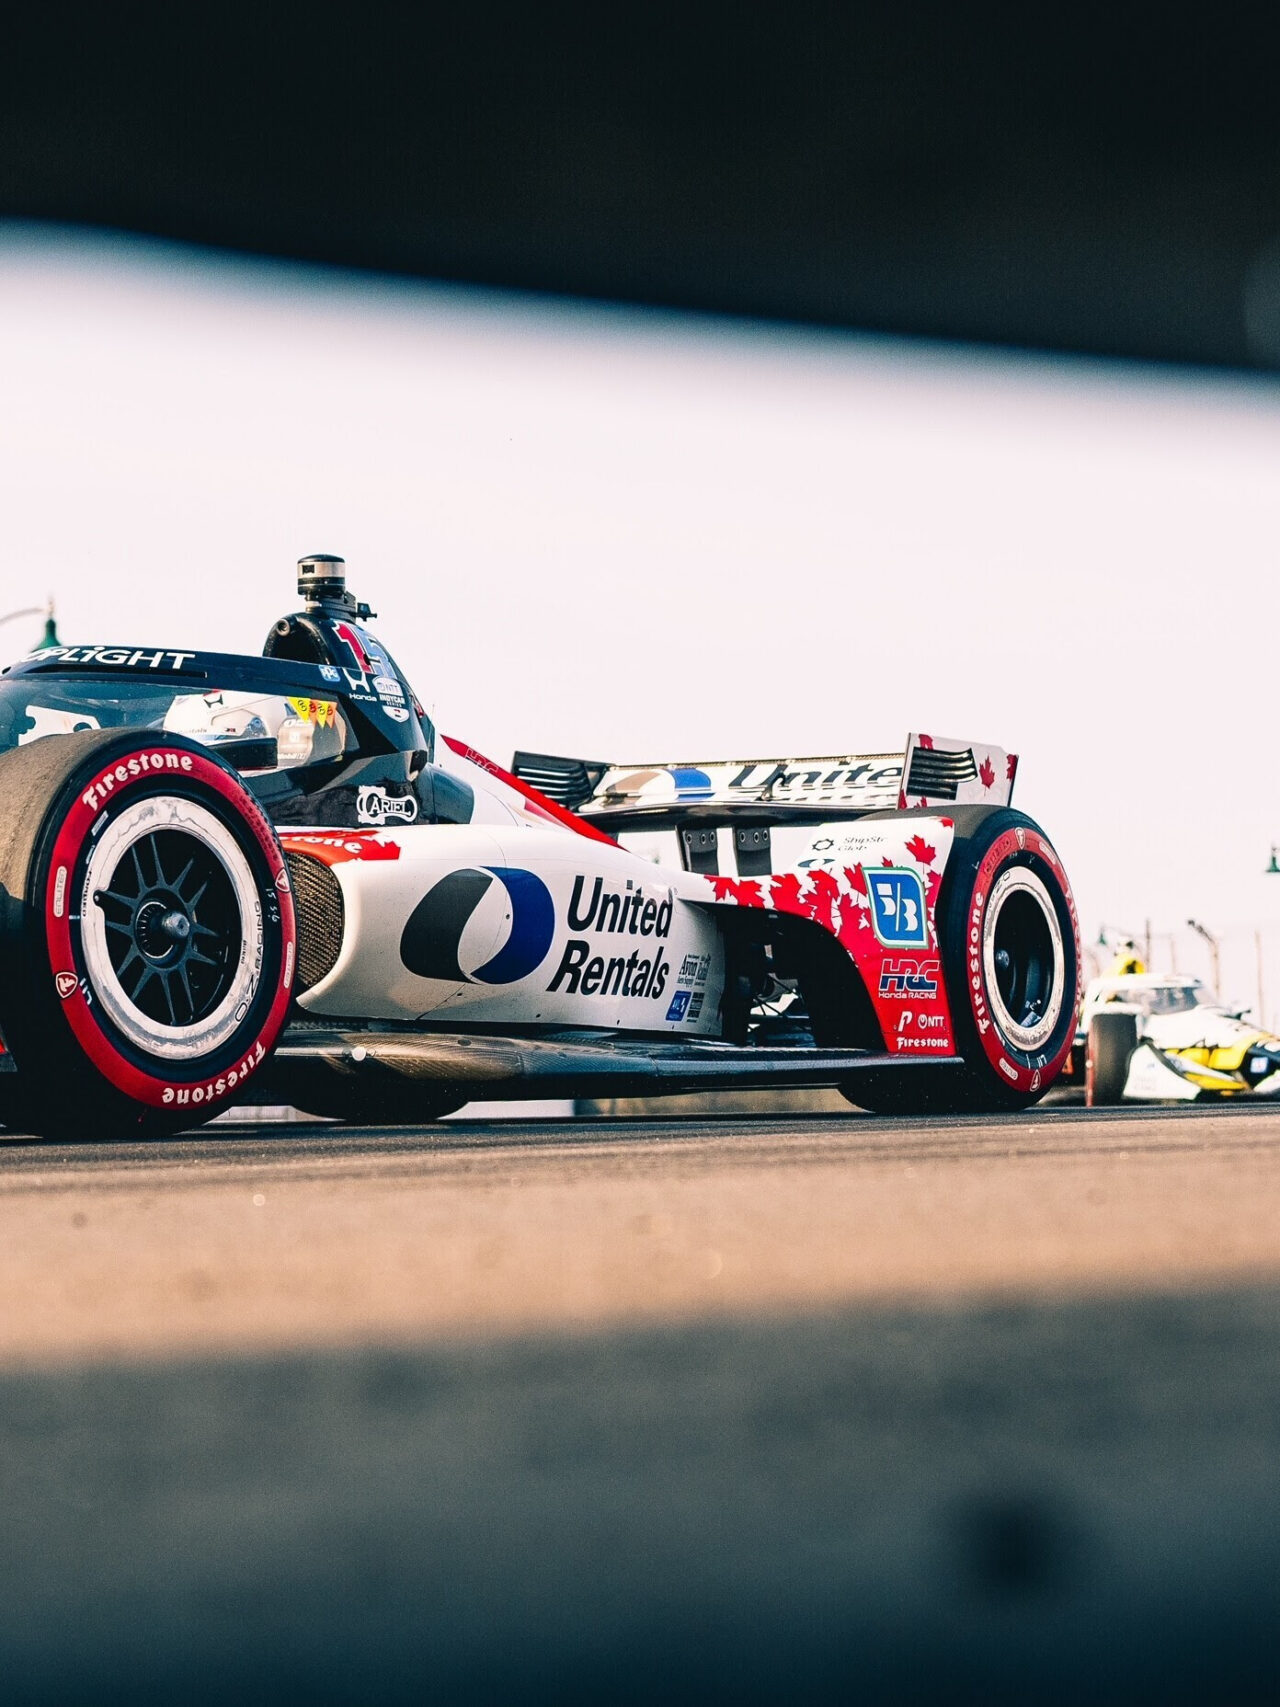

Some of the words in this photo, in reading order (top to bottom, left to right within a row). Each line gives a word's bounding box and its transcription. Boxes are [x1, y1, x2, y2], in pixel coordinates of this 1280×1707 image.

[349, 692, 378, 702] Honda
[82, 753, 193, 812] Firestone
[370, 796, 412, 817] ARIEL
[567, 875, 673, 938] United
[545, 939, 670, 999] Rentals
[878, 958, 941, 992] HRC
[969, 892, 991, 1035] Firestone
[878, 991, 907, 999] Honda
[908, 992, 937, 1000] RACING
[927, 1016, 945, 1027] NTT
[896, 1037, 949, 1050] Firestone
[161, 1041, 266, 1105] Firestone
